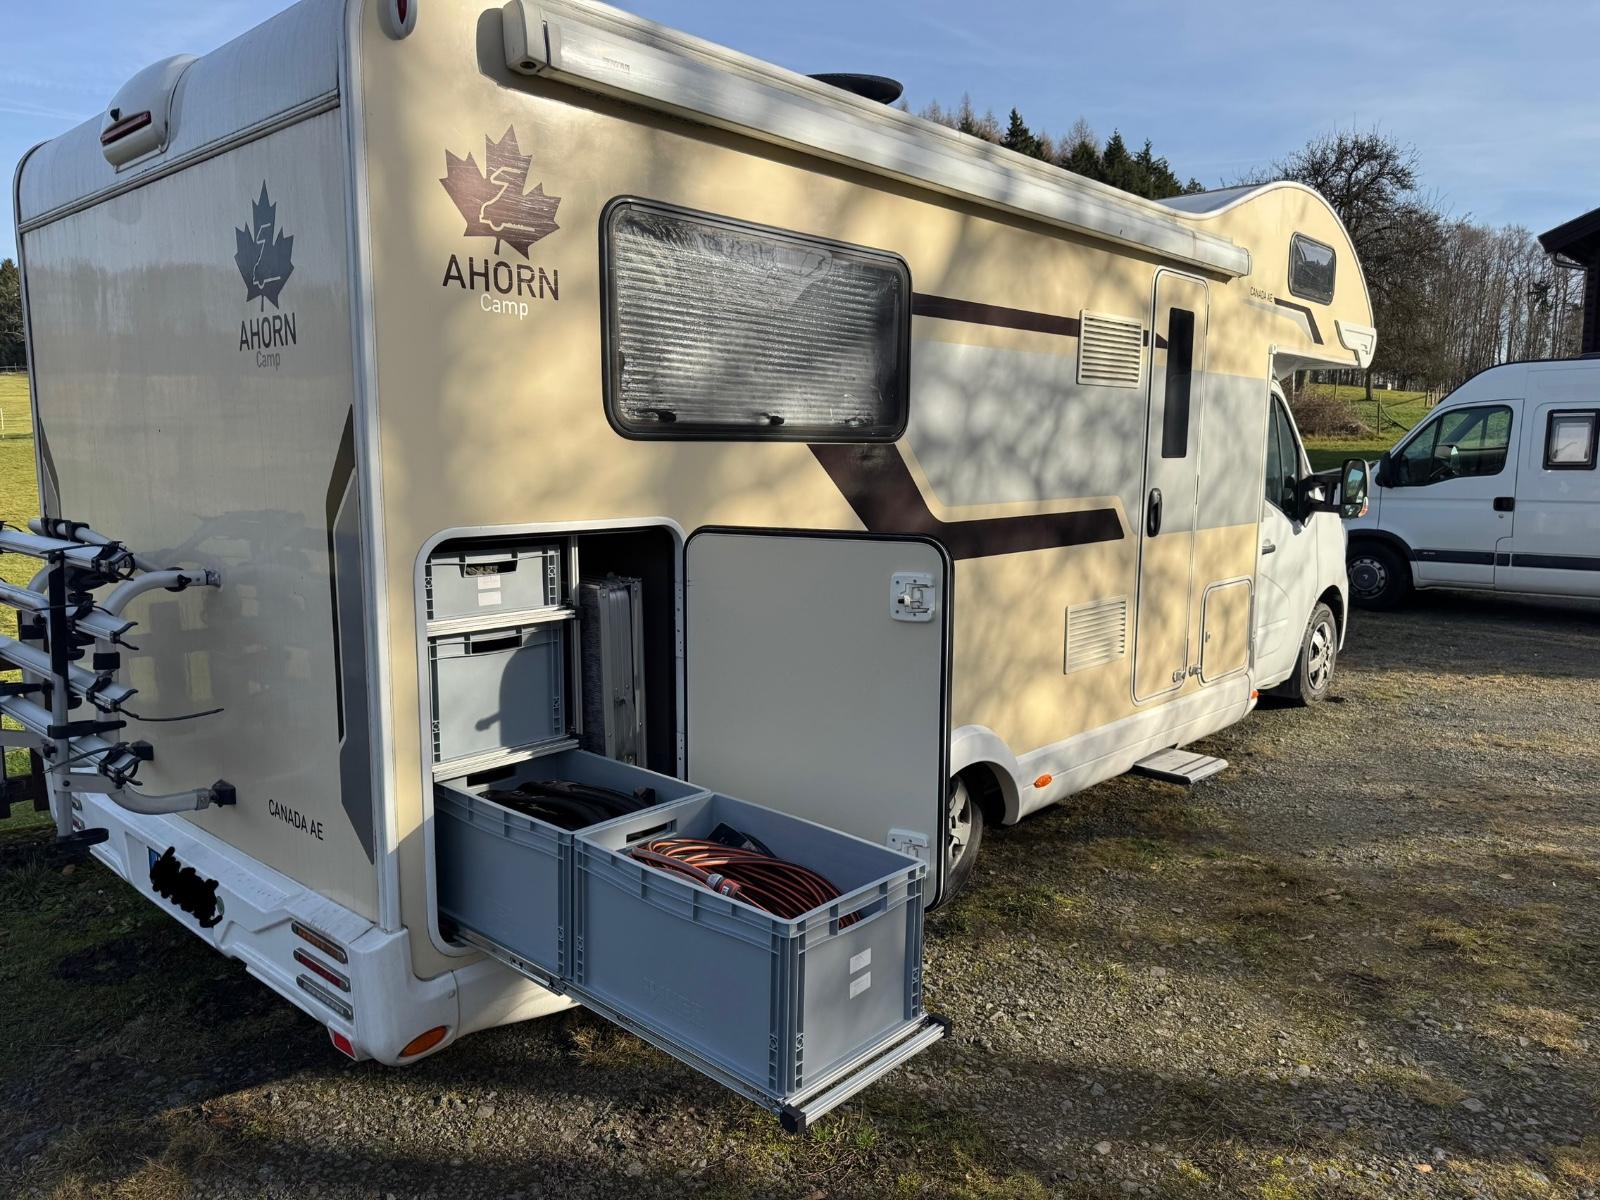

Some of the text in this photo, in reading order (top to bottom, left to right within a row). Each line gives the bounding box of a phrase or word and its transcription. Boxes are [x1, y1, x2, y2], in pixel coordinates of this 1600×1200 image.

[442, 253, 559, 301] AHORN
[480, 293, 528, 321] Camp
[239, 312, 297, 352] AHORN
[256, 350, 281, 372] Camp
[268, 799, 324, 841] CANADA AE
